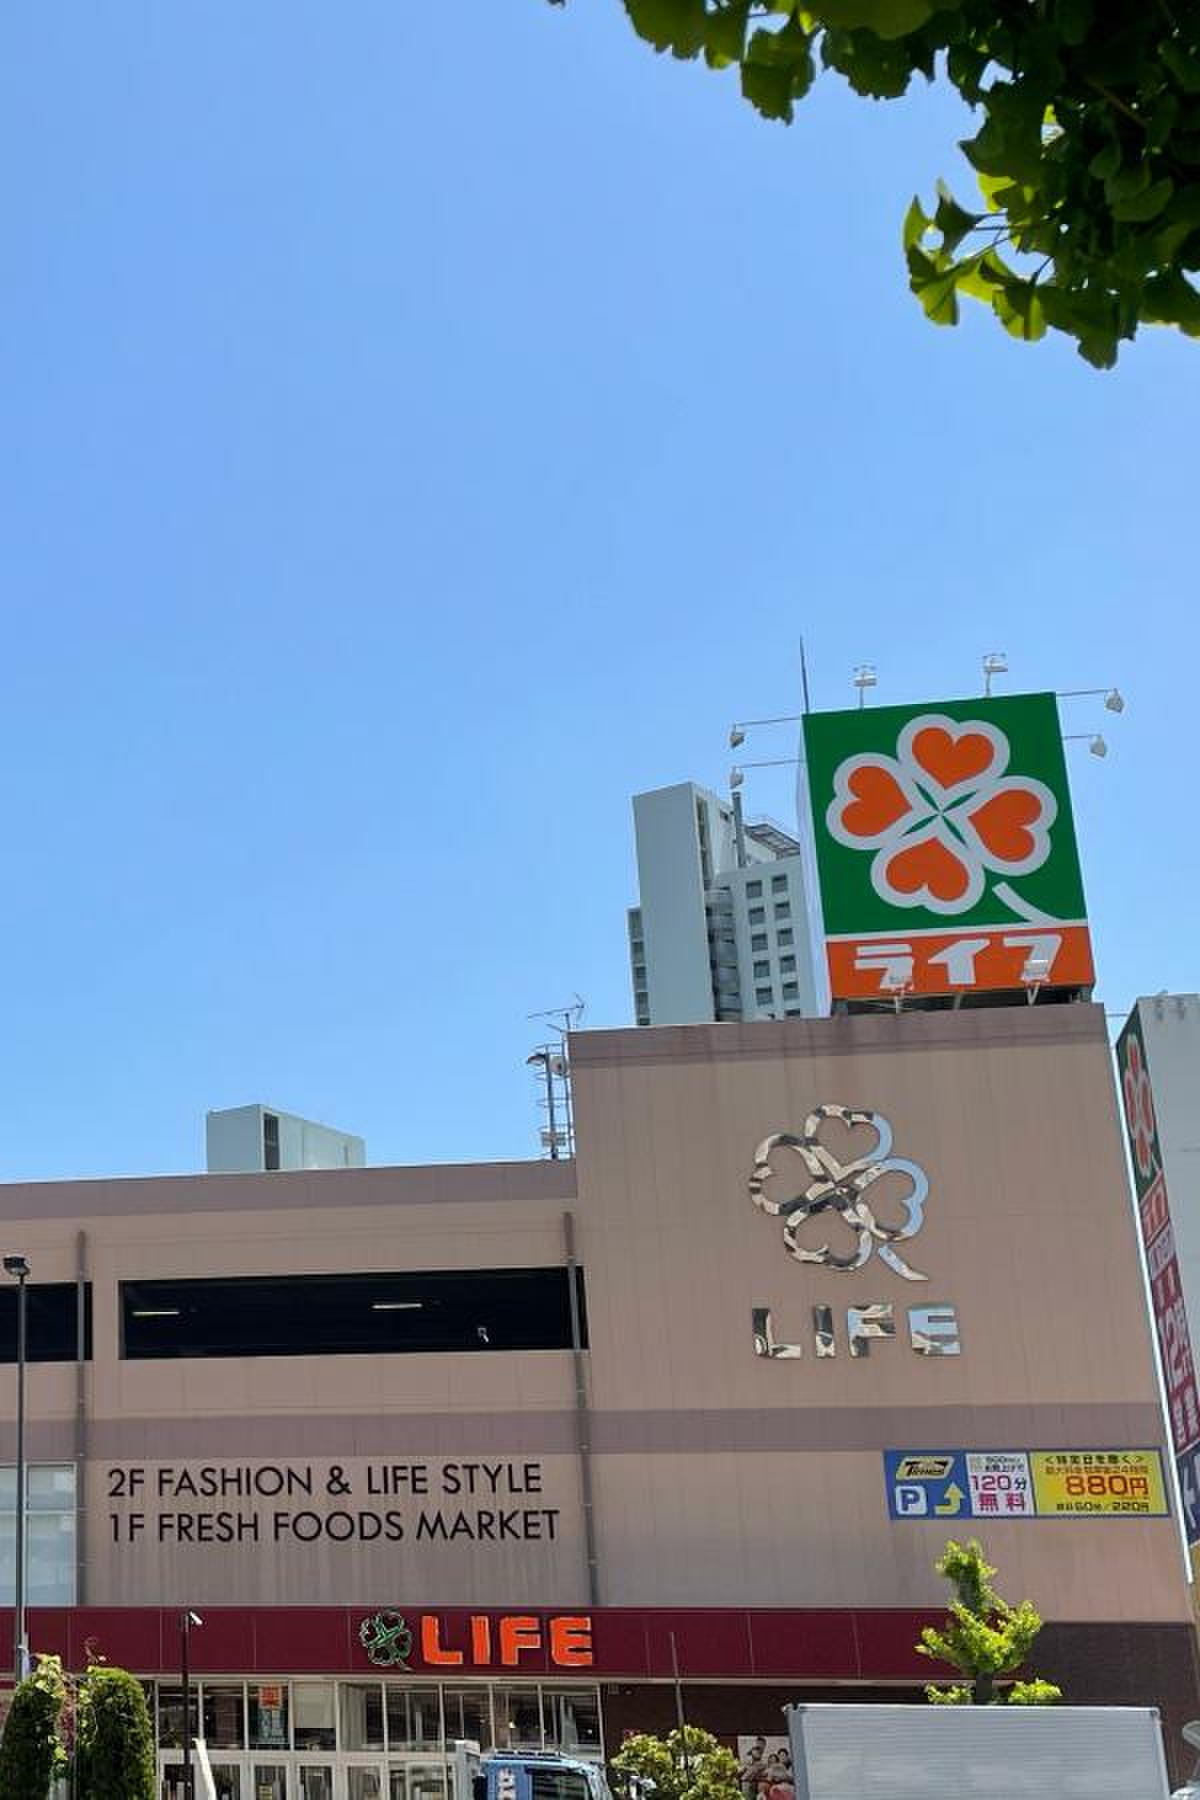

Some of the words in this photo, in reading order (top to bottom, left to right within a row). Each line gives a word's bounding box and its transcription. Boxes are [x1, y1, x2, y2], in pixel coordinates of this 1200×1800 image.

[854, 934, 1062, 989] ライフ
[751, 1302, 961, 1358] LIFE
[108, 1467, 145, 1498] 2F
[158, 1466, 312, 1497] FASHION
[326, 1465, 353, 1497] &
[367, 1465, 429, 1495] LIFE
[441, 1463, 542, 1495] STYLE
[970, 1475, 1026, 1490] 120分
[1065, 1475, 1149, 1496] 880円
[900, 1489, 920, 1511] P
[978, 1492, 1026, 1511] 無料
[109, 1513, 145, 1543] 1F
[158, 1511, 259, 1543] FRESH
[273, 1510, 404, 1542] FOODS
[415, 1509, 561, 1541] MARKET
[421, 1614, 593, 1666] LIFE
